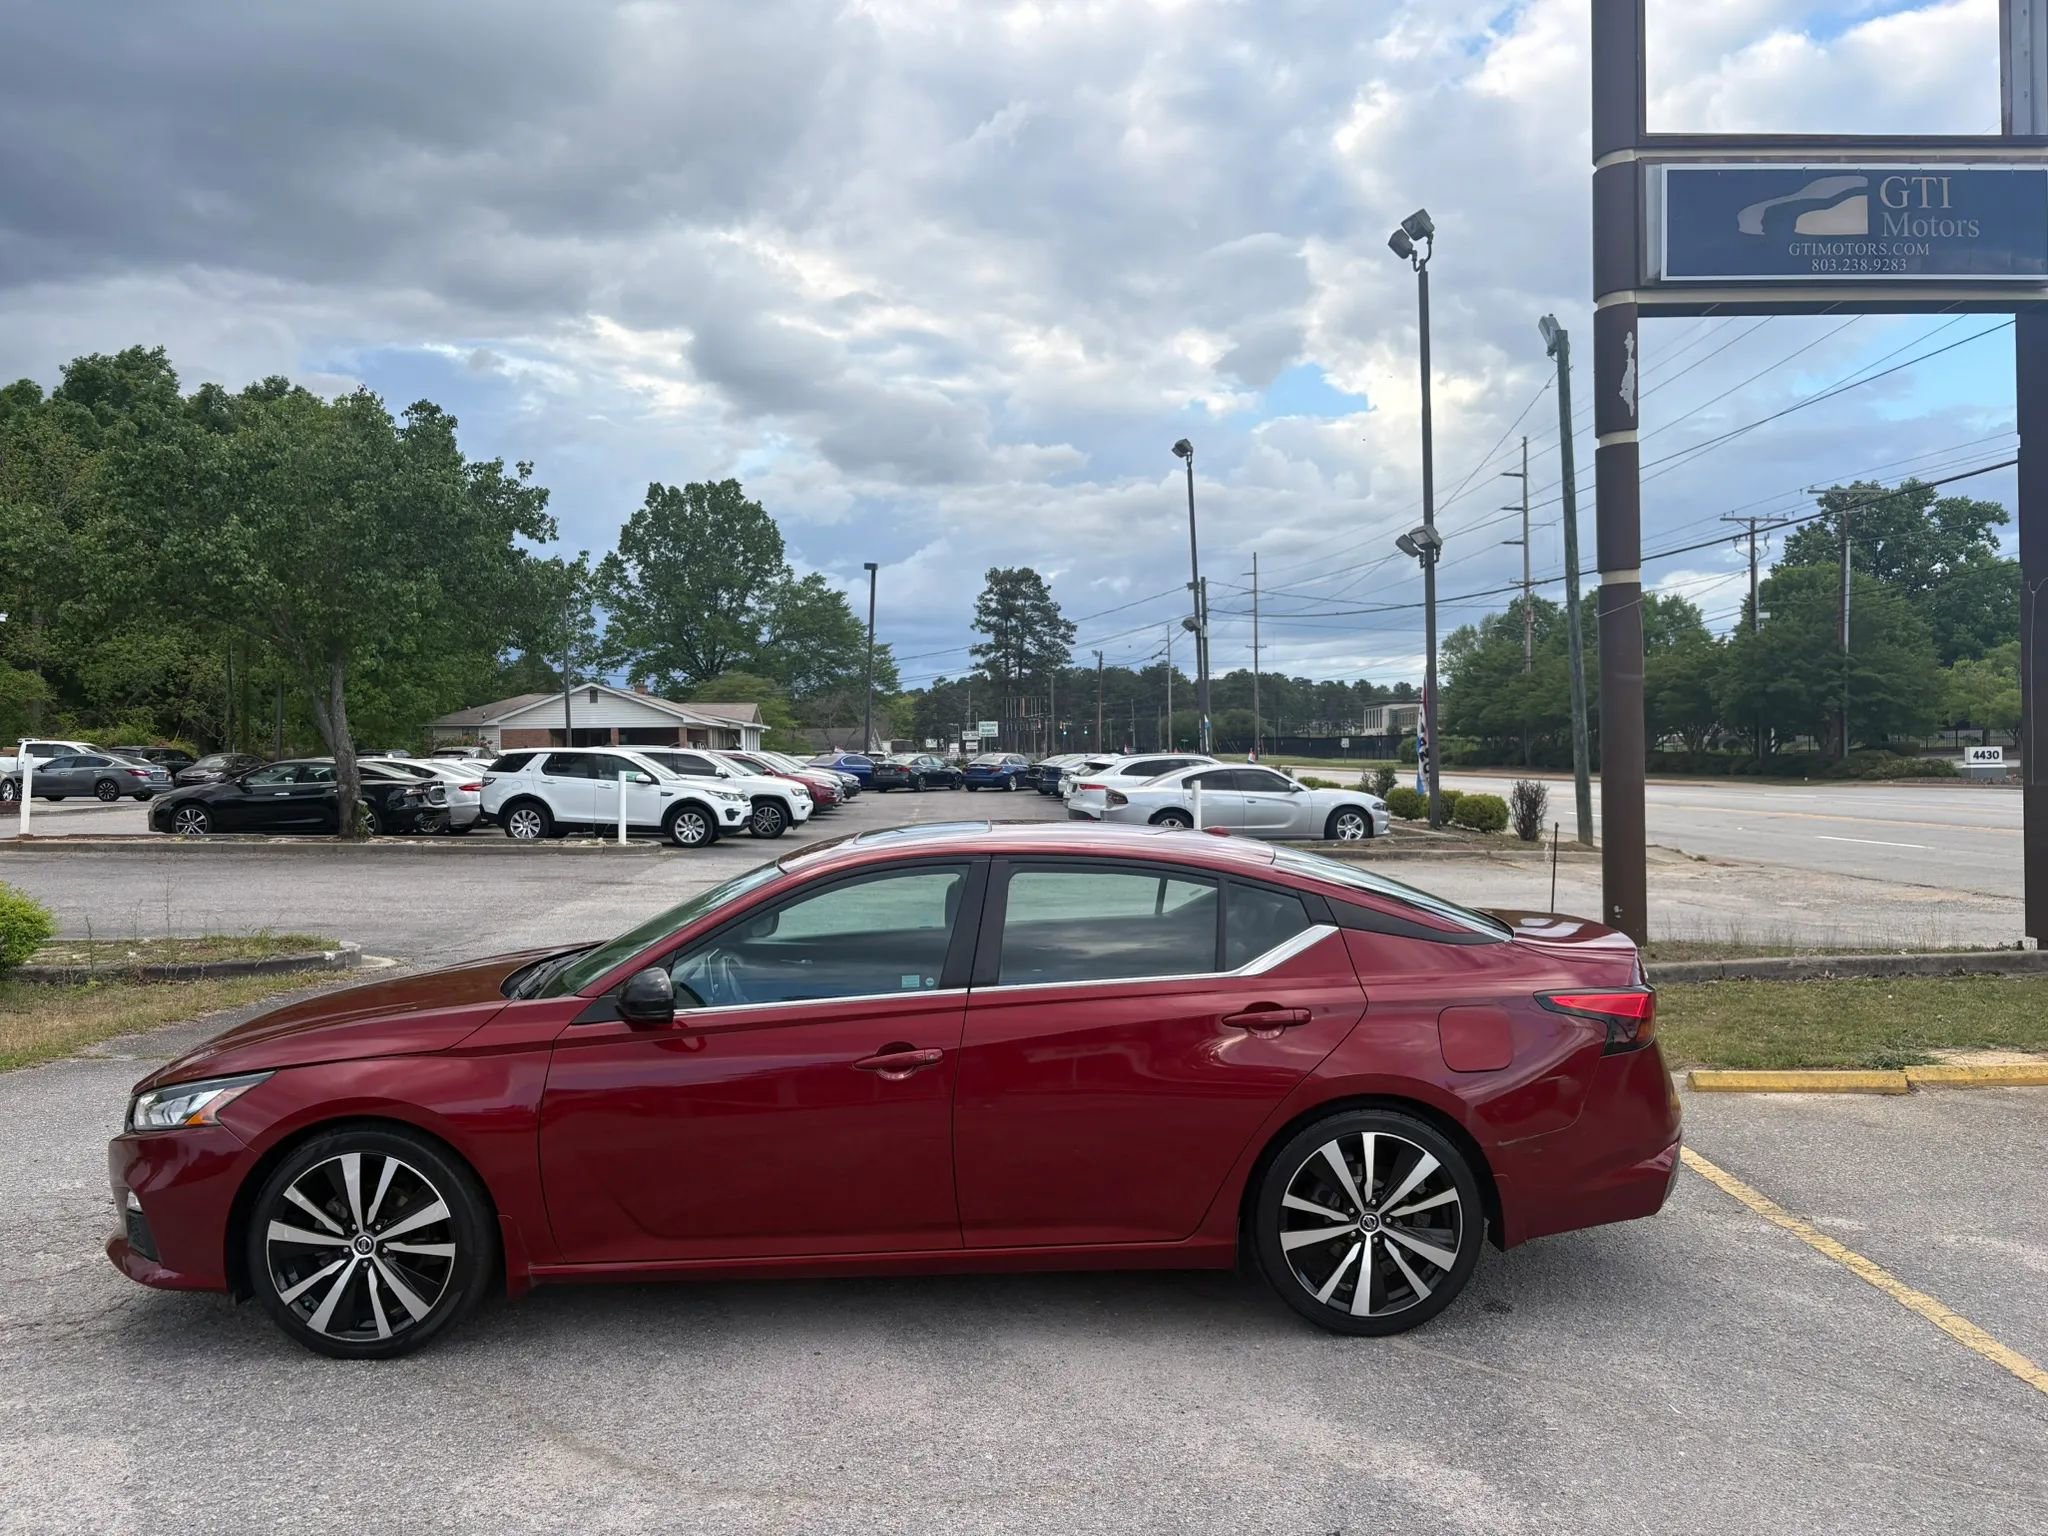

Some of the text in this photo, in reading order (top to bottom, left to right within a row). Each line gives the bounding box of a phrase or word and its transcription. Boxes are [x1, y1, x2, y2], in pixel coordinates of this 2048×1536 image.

[1880, 176, 1952, 209] GTI
[1881, 212, 1980, 237] Motors
[1788, 243, 1930, 256] GTIMOTORS.COM
[1811, 258, 1907, 271] 803.238.9283
[1973, 750, 2000, 760] 4430
